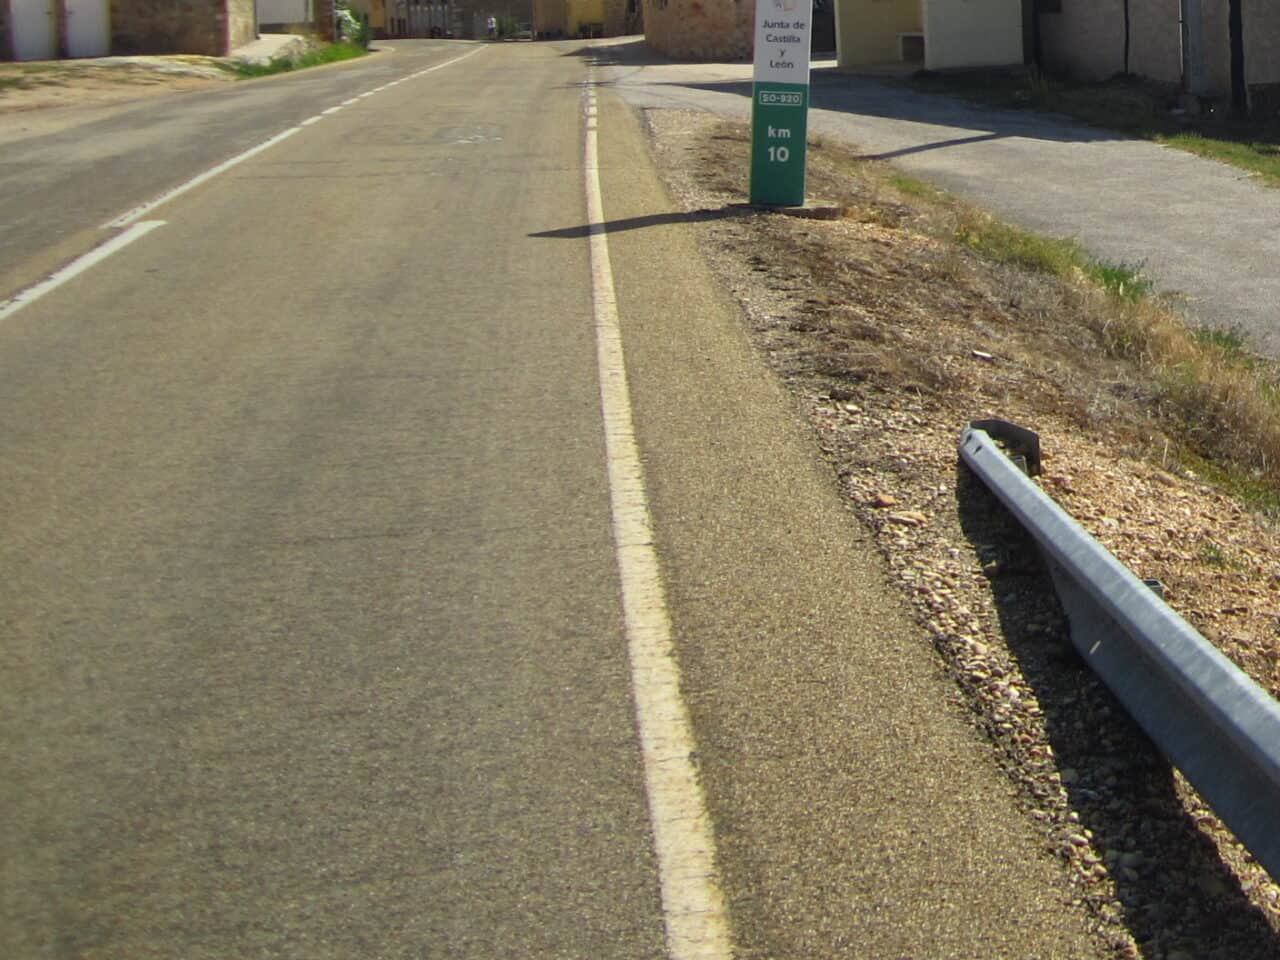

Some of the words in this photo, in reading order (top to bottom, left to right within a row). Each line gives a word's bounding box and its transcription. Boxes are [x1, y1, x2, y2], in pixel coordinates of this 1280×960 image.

[763, 20, 790, 29] Junta
[792, 21, 806, 30] de
[766, 34, 801, 43] Castilla
[780, 49, 786, 57] y
[769, 59, 794, 69] León
[762, 93, 800, 103] SO-920
[768, 125, 791, 138] km
[768, 146, 790, 162] 10
